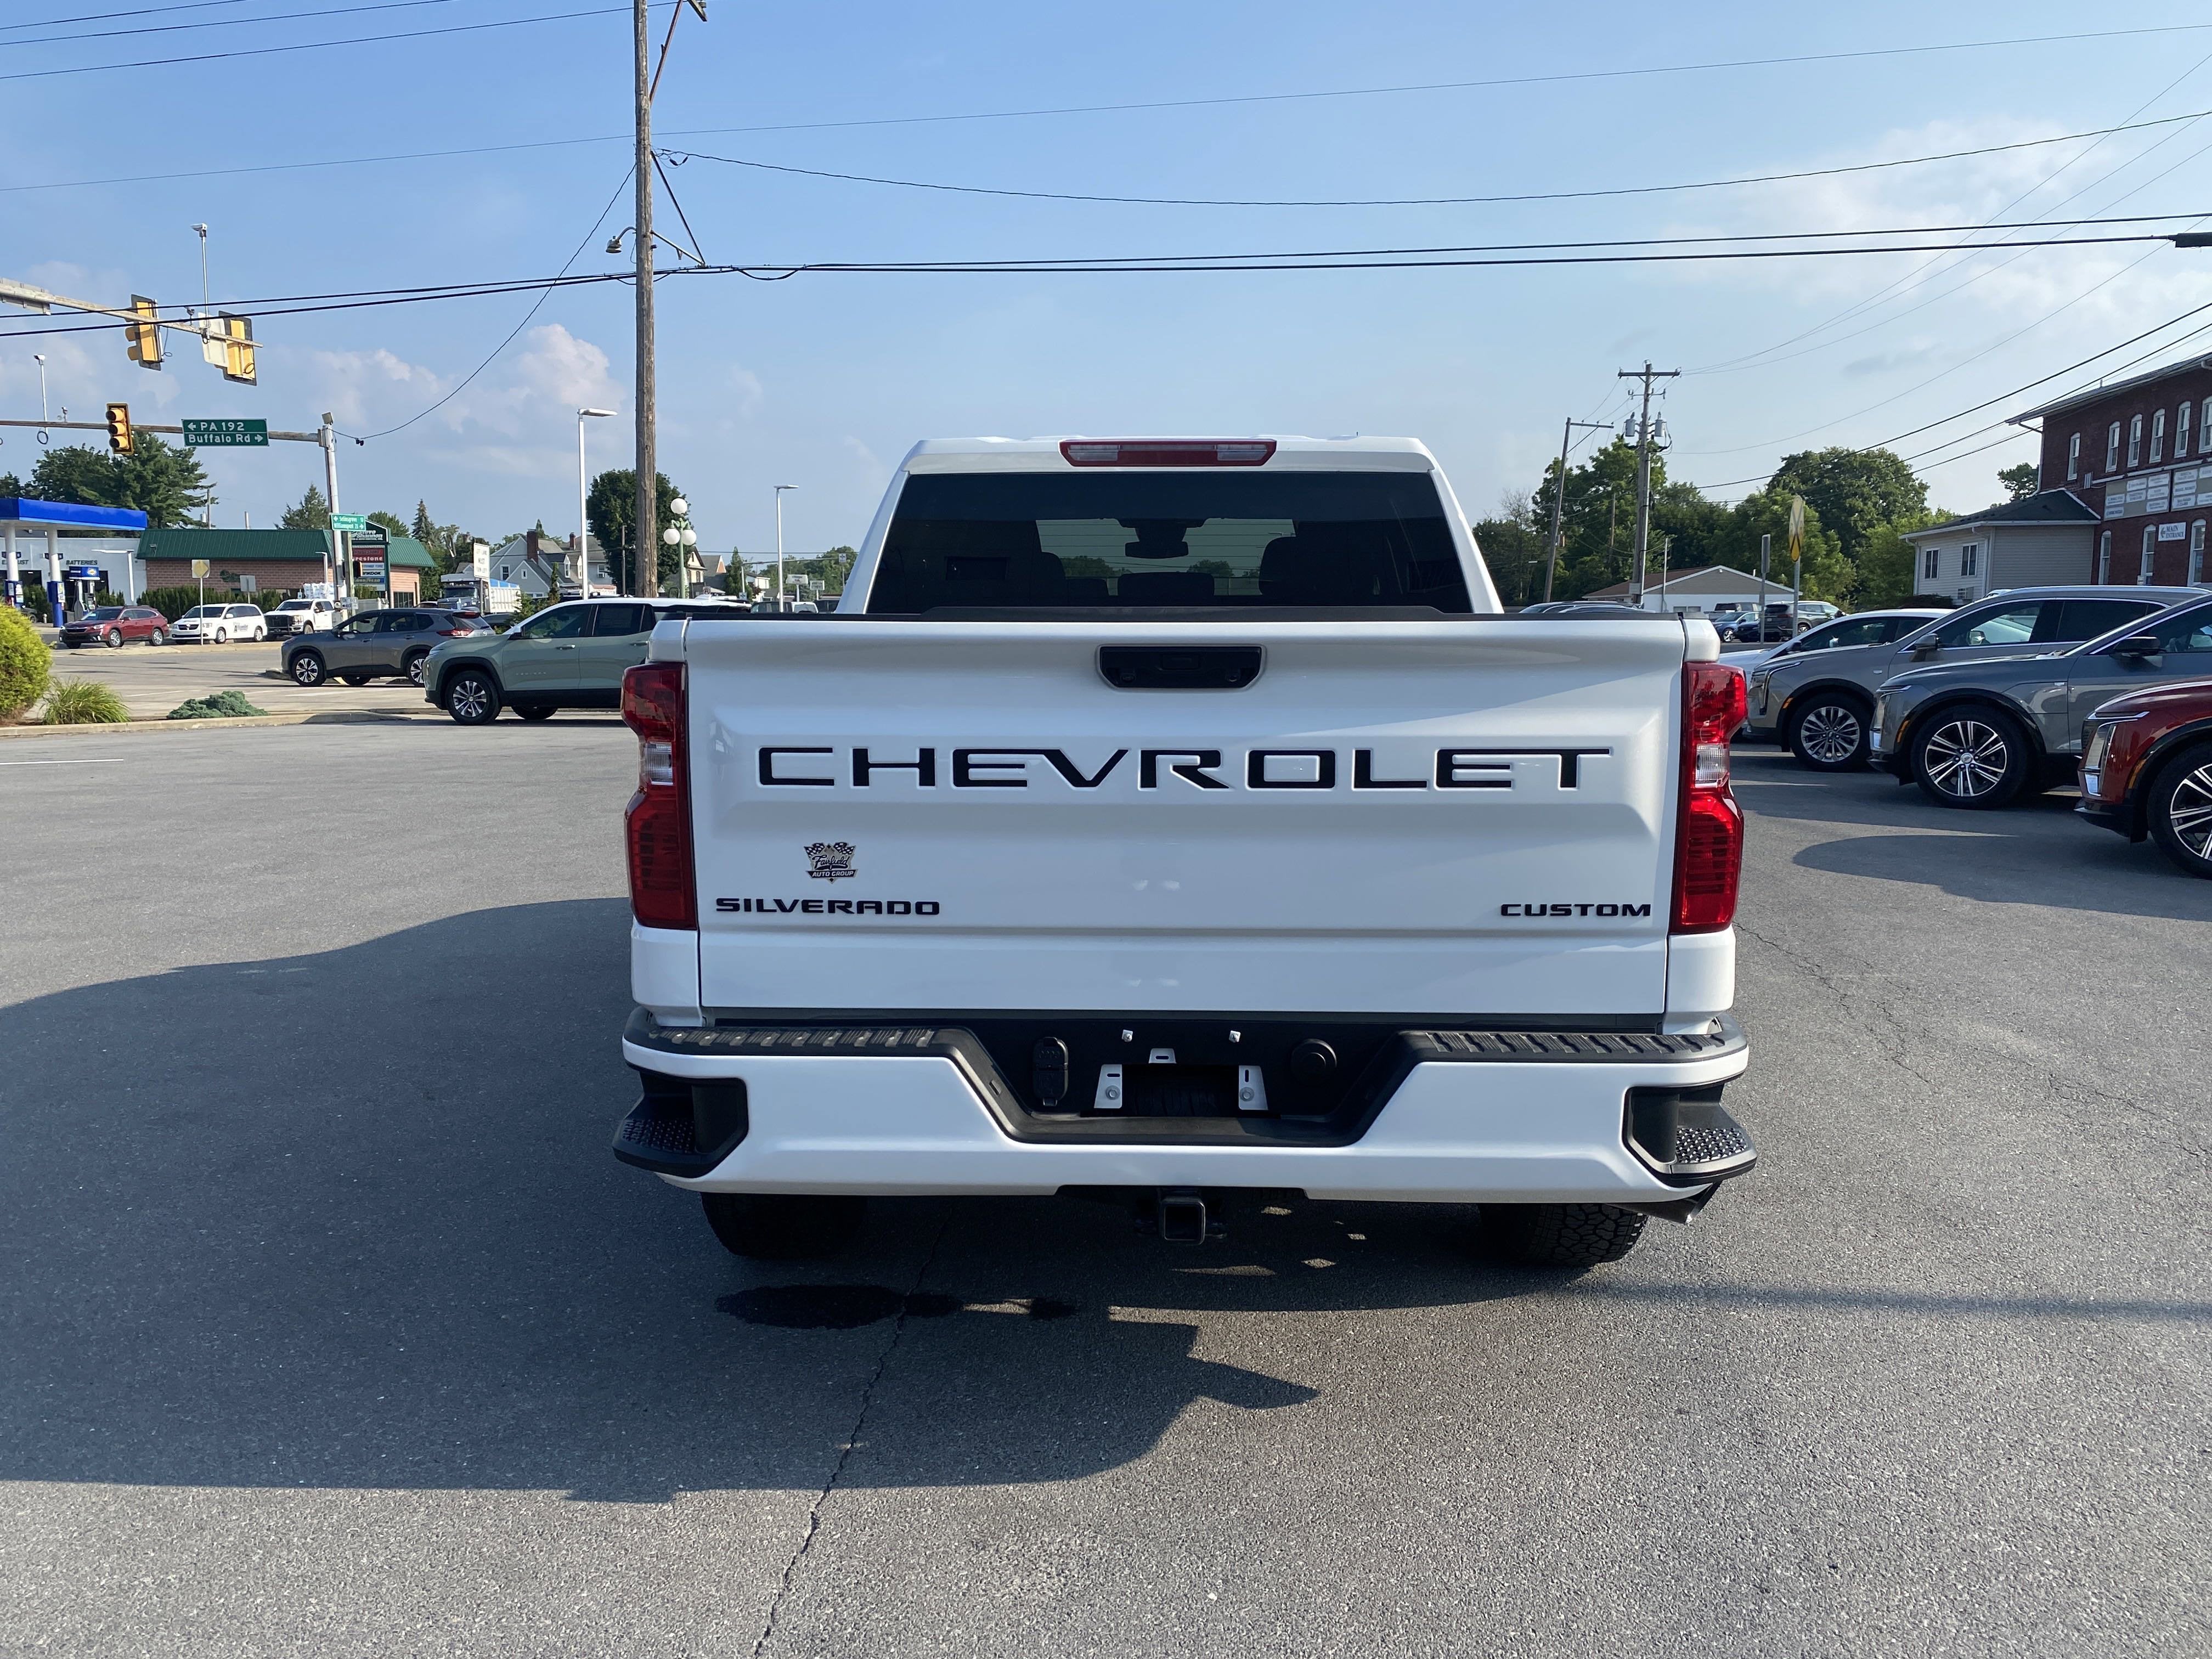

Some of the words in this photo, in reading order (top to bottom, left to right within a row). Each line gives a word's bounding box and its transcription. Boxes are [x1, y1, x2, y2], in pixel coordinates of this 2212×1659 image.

[200, 422, 218, 431] PA
[222, 422, 245, 431] 192
[188, 433, 232, 443] Buffalo
[235, 433, 251, 442] Rd
[759, 748, 1611, 789] CHEVROLET
[812, 854, 850, 869] Fairfield
[716, 898, 940, 916] SILVERADO
[1501, 904, 1651, 916] CUSTOM
